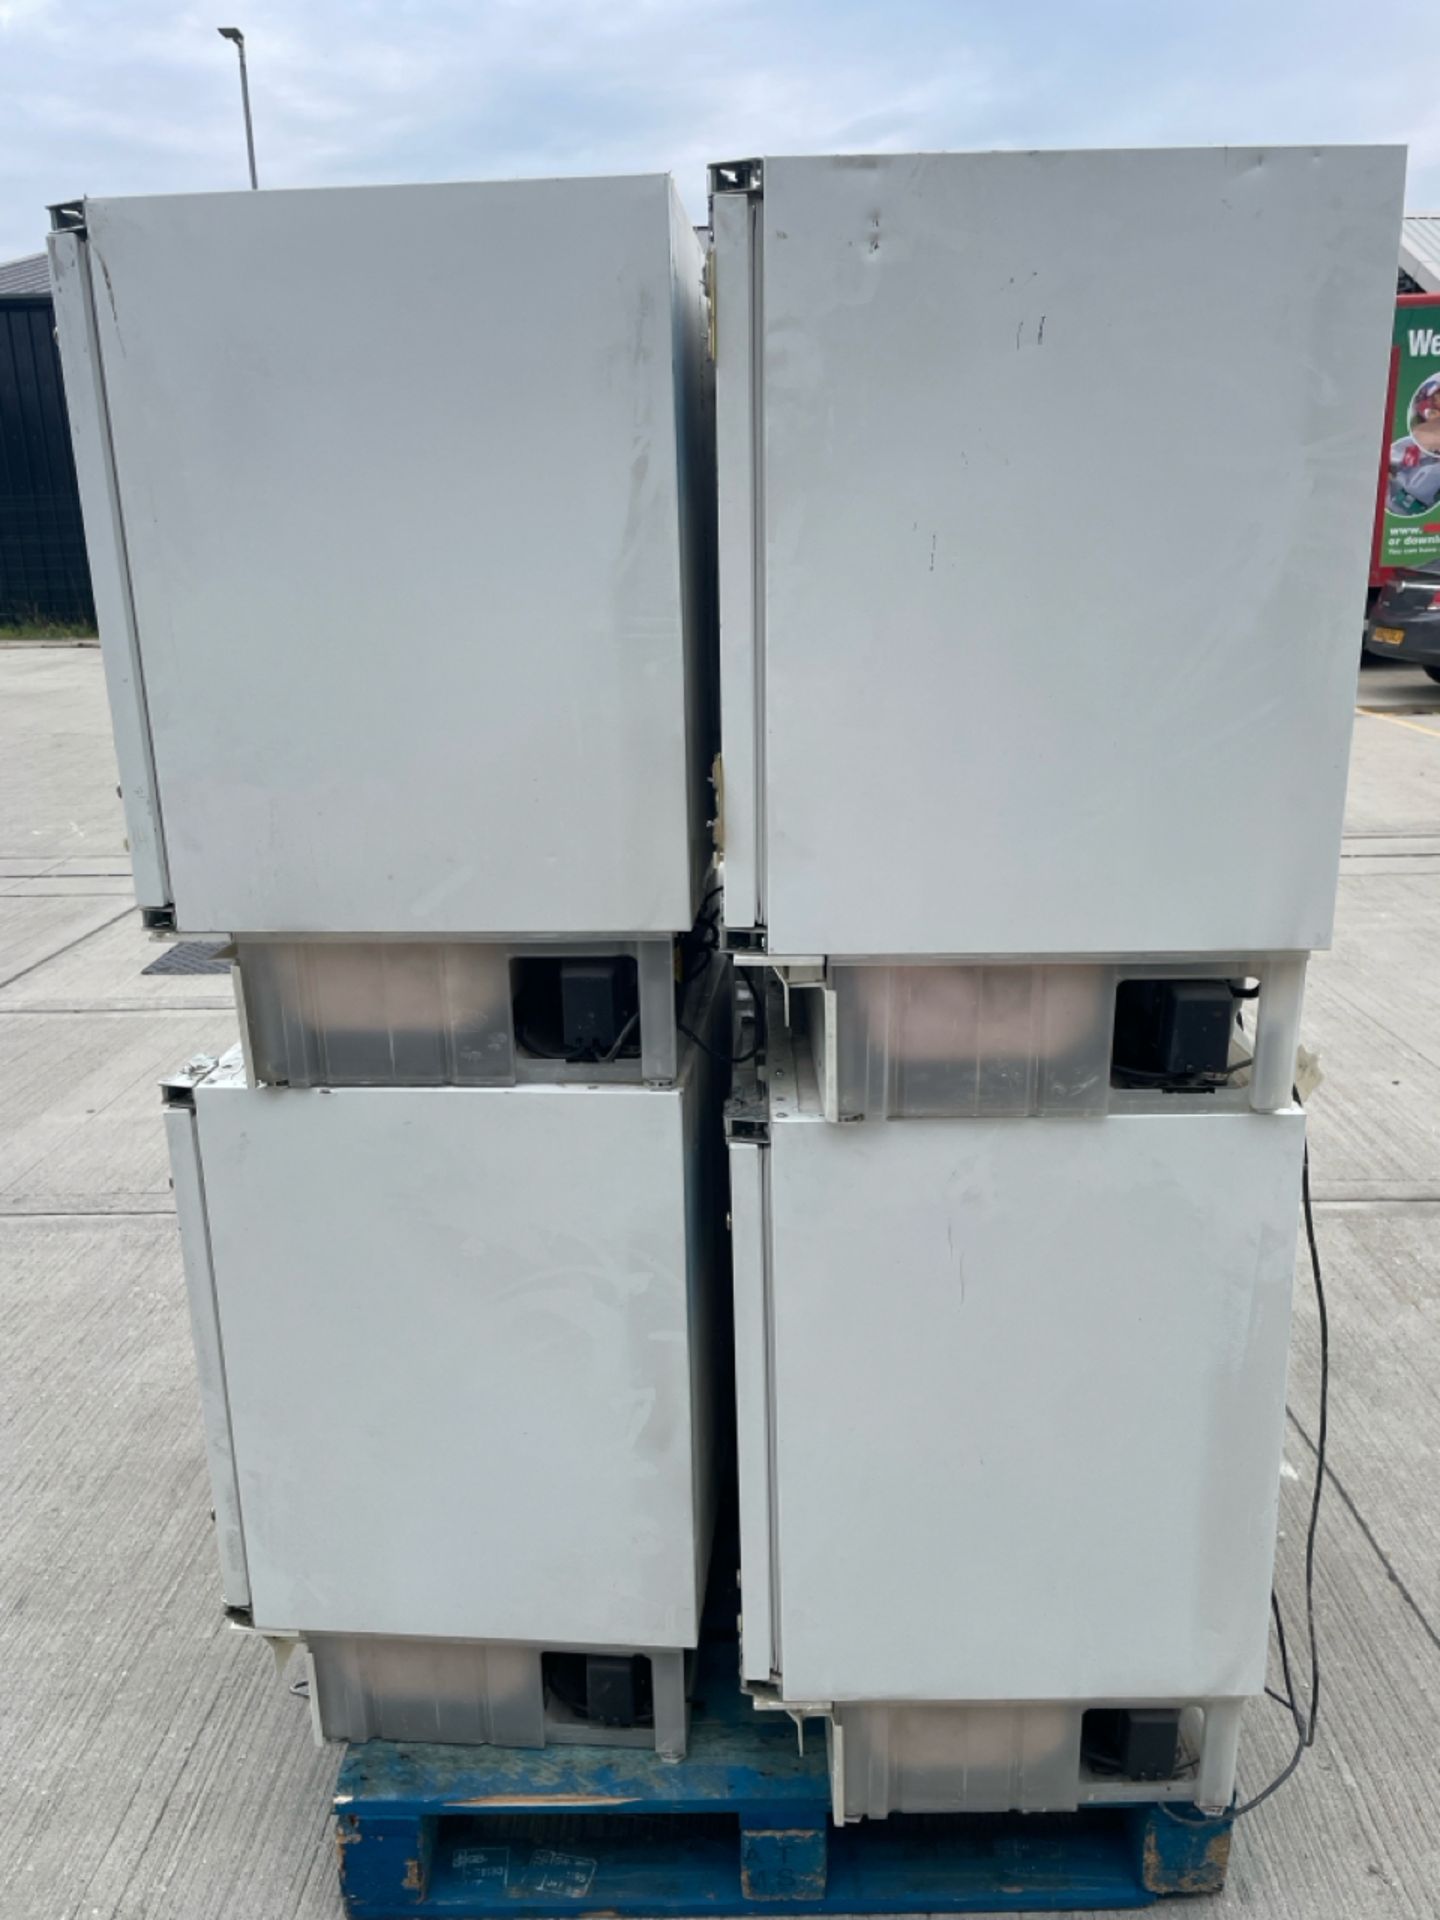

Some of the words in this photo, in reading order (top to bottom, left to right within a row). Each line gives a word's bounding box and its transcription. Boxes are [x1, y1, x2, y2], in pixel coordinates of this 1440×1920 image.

[1409, 329, 1440, 357] We
[1390, 528, 1423, 536] www.
[1388, 537, 1401, 546] or
[1403, 535, 1440, 545] downl
